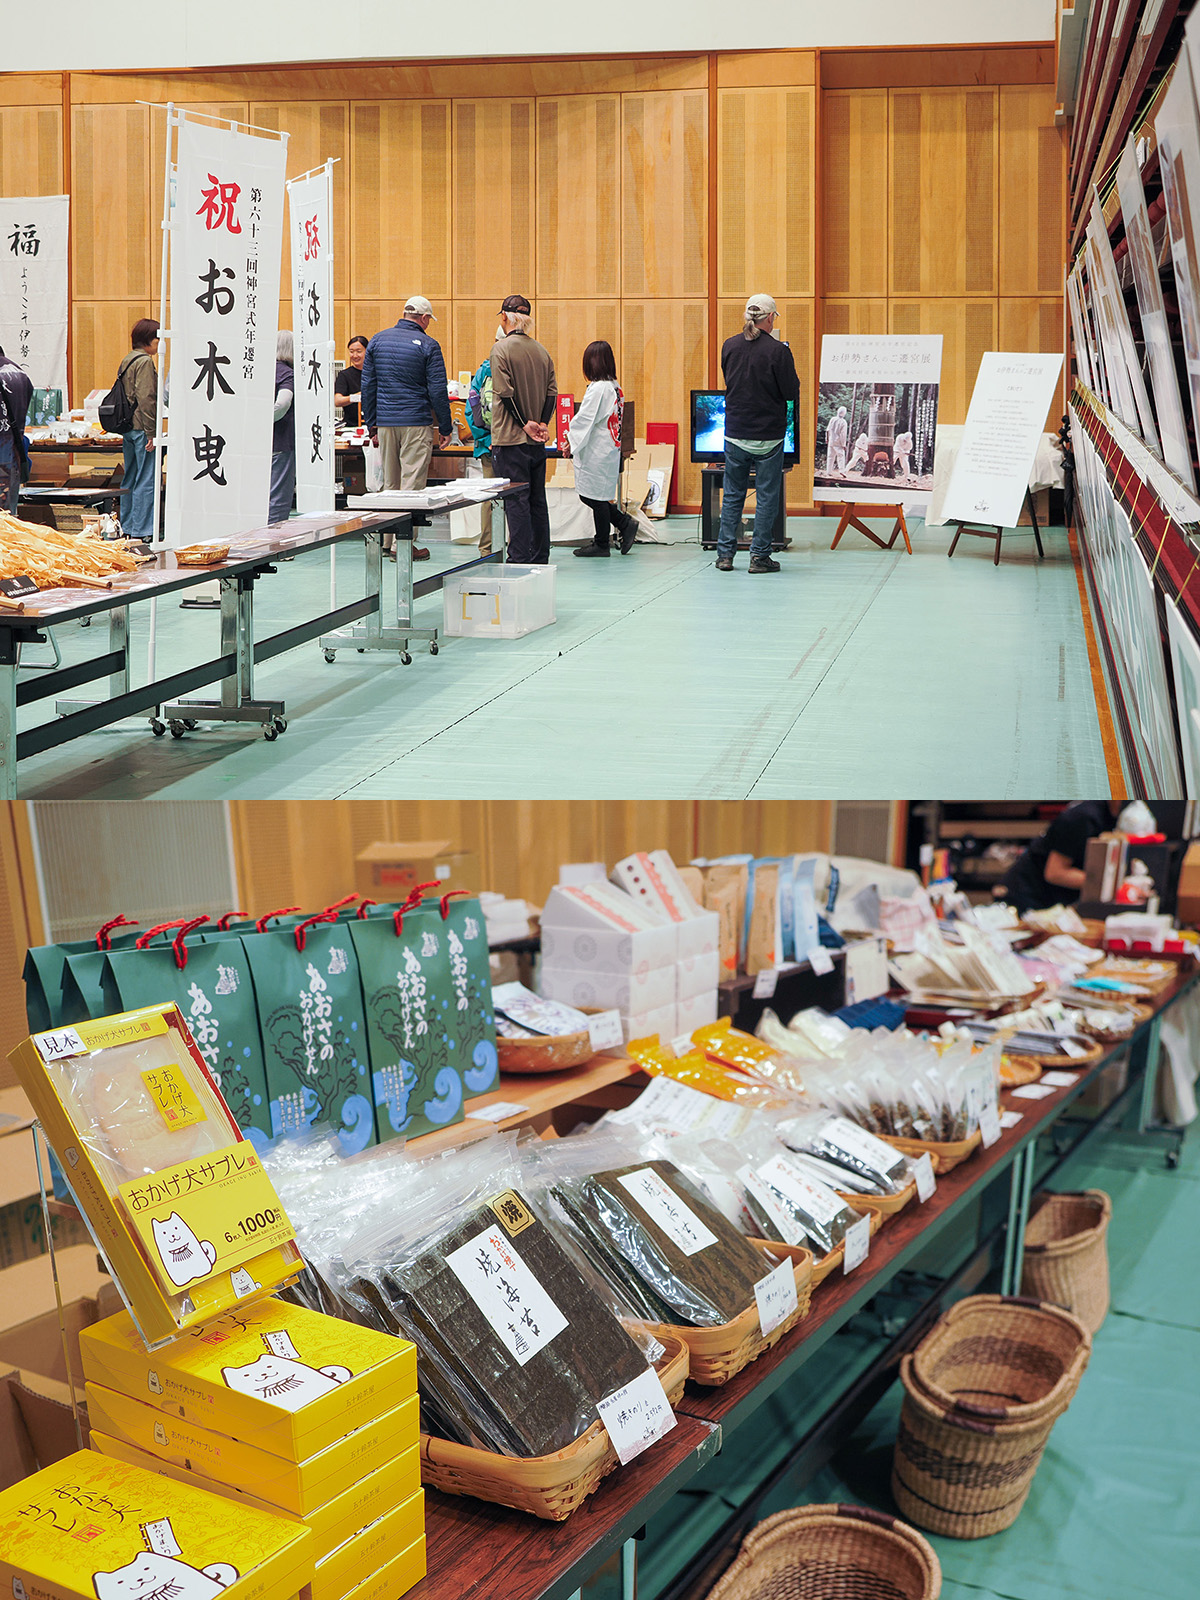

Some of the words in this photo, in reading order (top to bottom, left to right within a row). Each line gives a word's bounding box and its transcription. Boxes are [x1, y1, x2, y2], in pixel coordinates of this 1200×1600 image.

[7, 223, 41, 257] 福
[19, 266, 31, 368] ようこそ伊勢へ
[242, 187, 263, 380] 第六十三回神宮式年遷宮
[306, 962, 335, 1061] あおさの
[396, 971, 416, 1049] おかげせん
[402, 946, 429, 1035] あおさの
[44, 1034, 80, 1056] 見本
[85, 1025, 142, 1046] おかげ犬サブレ
[299, 990, 319, 1075] おかげせん
[161, 1069, 193, 1118] おかげ犬
[127, 1153, 246, 1212] おかげ犬サブレ
[50, 1483, 142, 1525] おかげ犬
